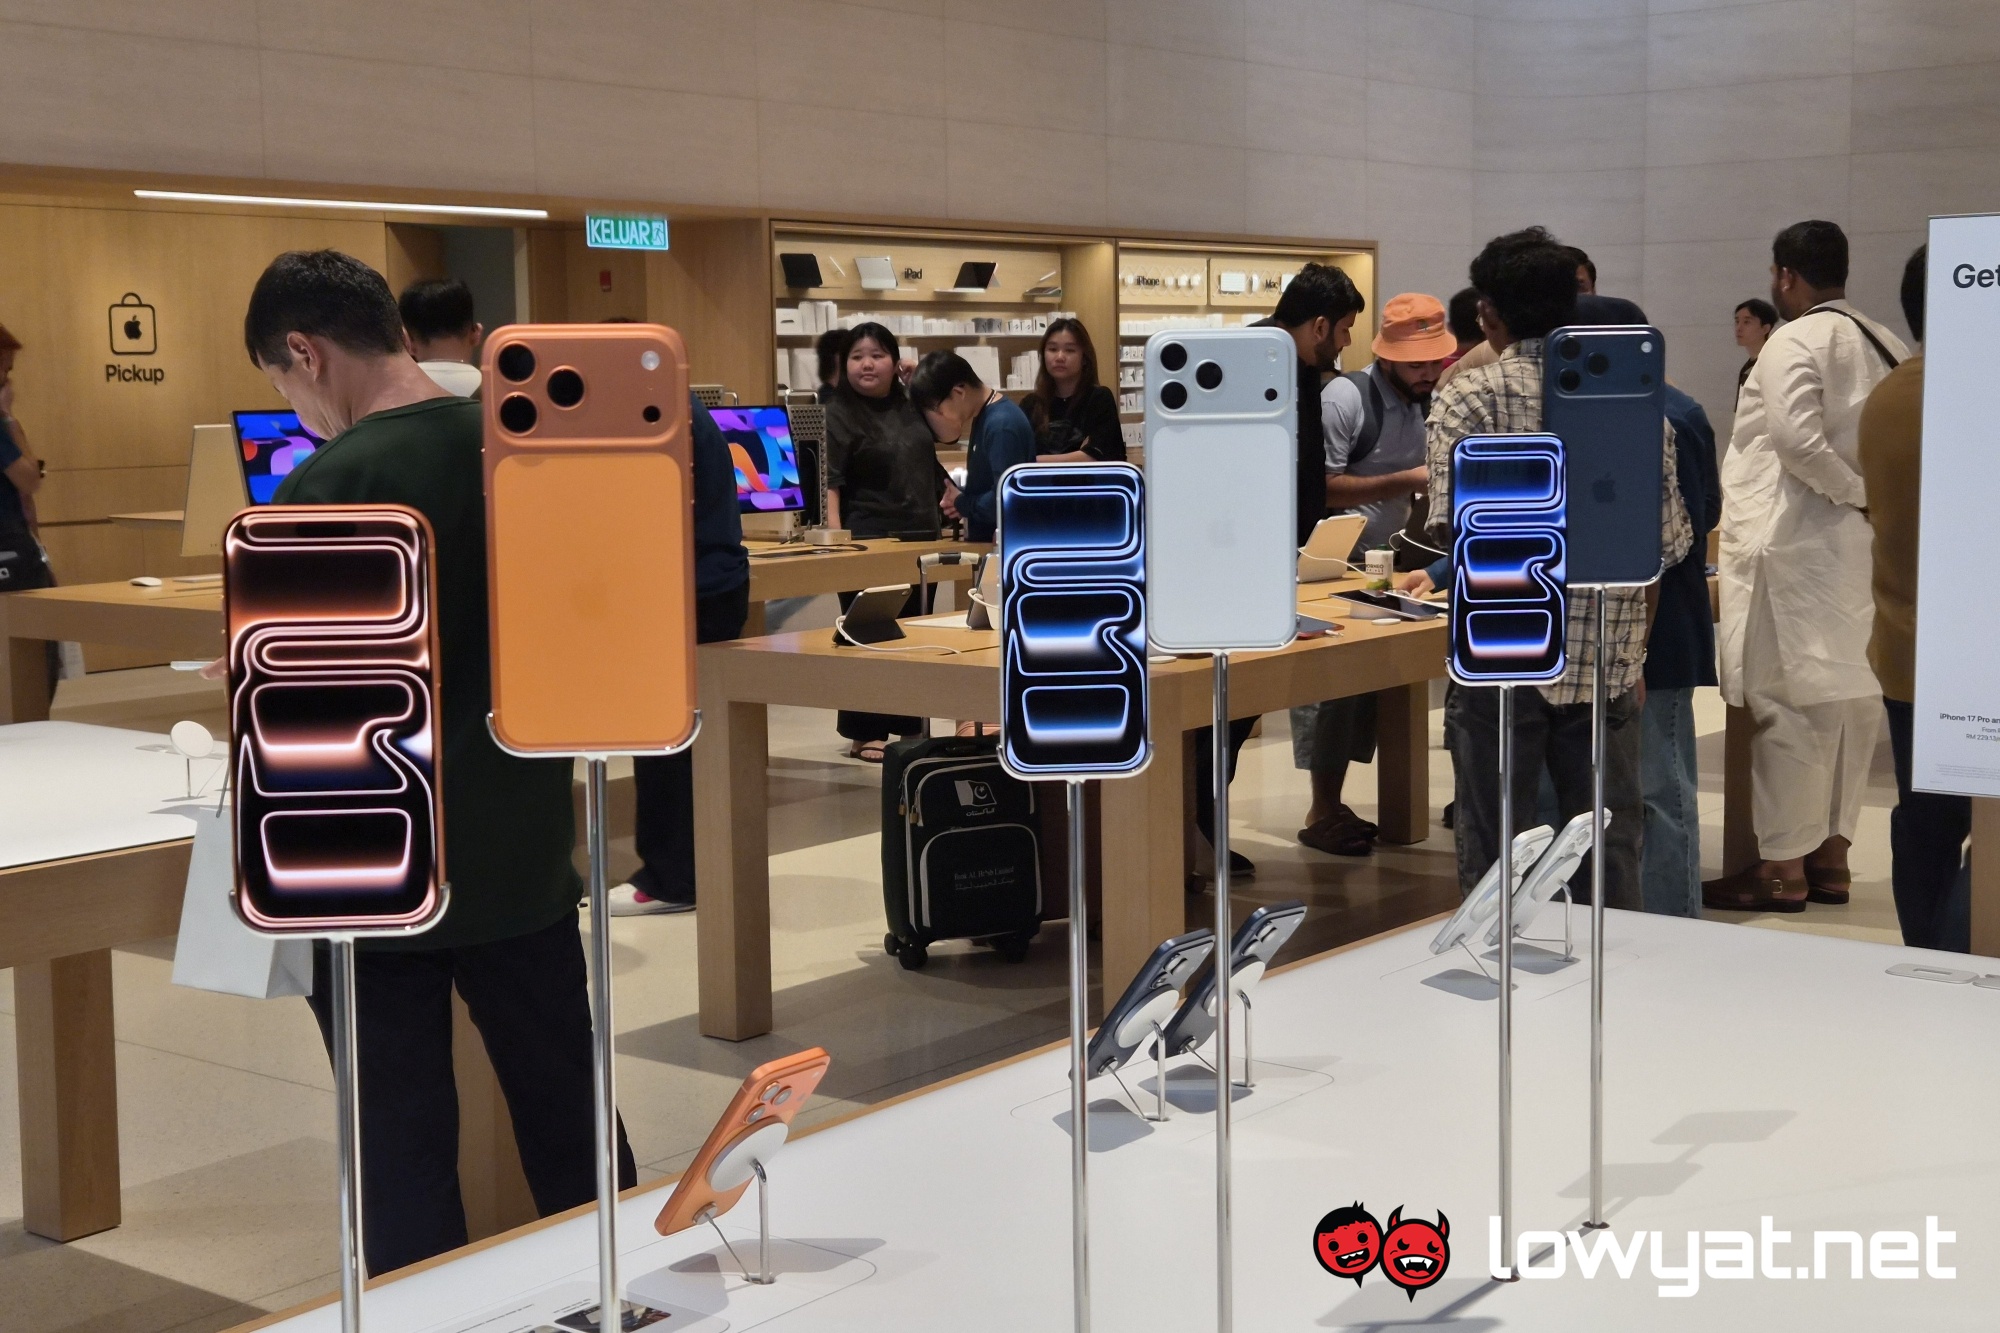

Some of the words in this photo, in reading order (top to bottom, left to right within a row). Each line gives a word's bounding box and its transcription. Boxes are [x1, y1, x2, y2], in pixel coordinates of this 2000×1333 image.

[590, 219, 650, 246] KELUAR
[904, 267, 922, 279] iPad
[1136, 275, 1160, 286] iPhone
[1265, 278, 1278, 289] Mac
[105, 364, 165, 385] Pickup
[1940, 713, 1965, 721] iPhone
[1977, 715, 1990, 723] Pro
